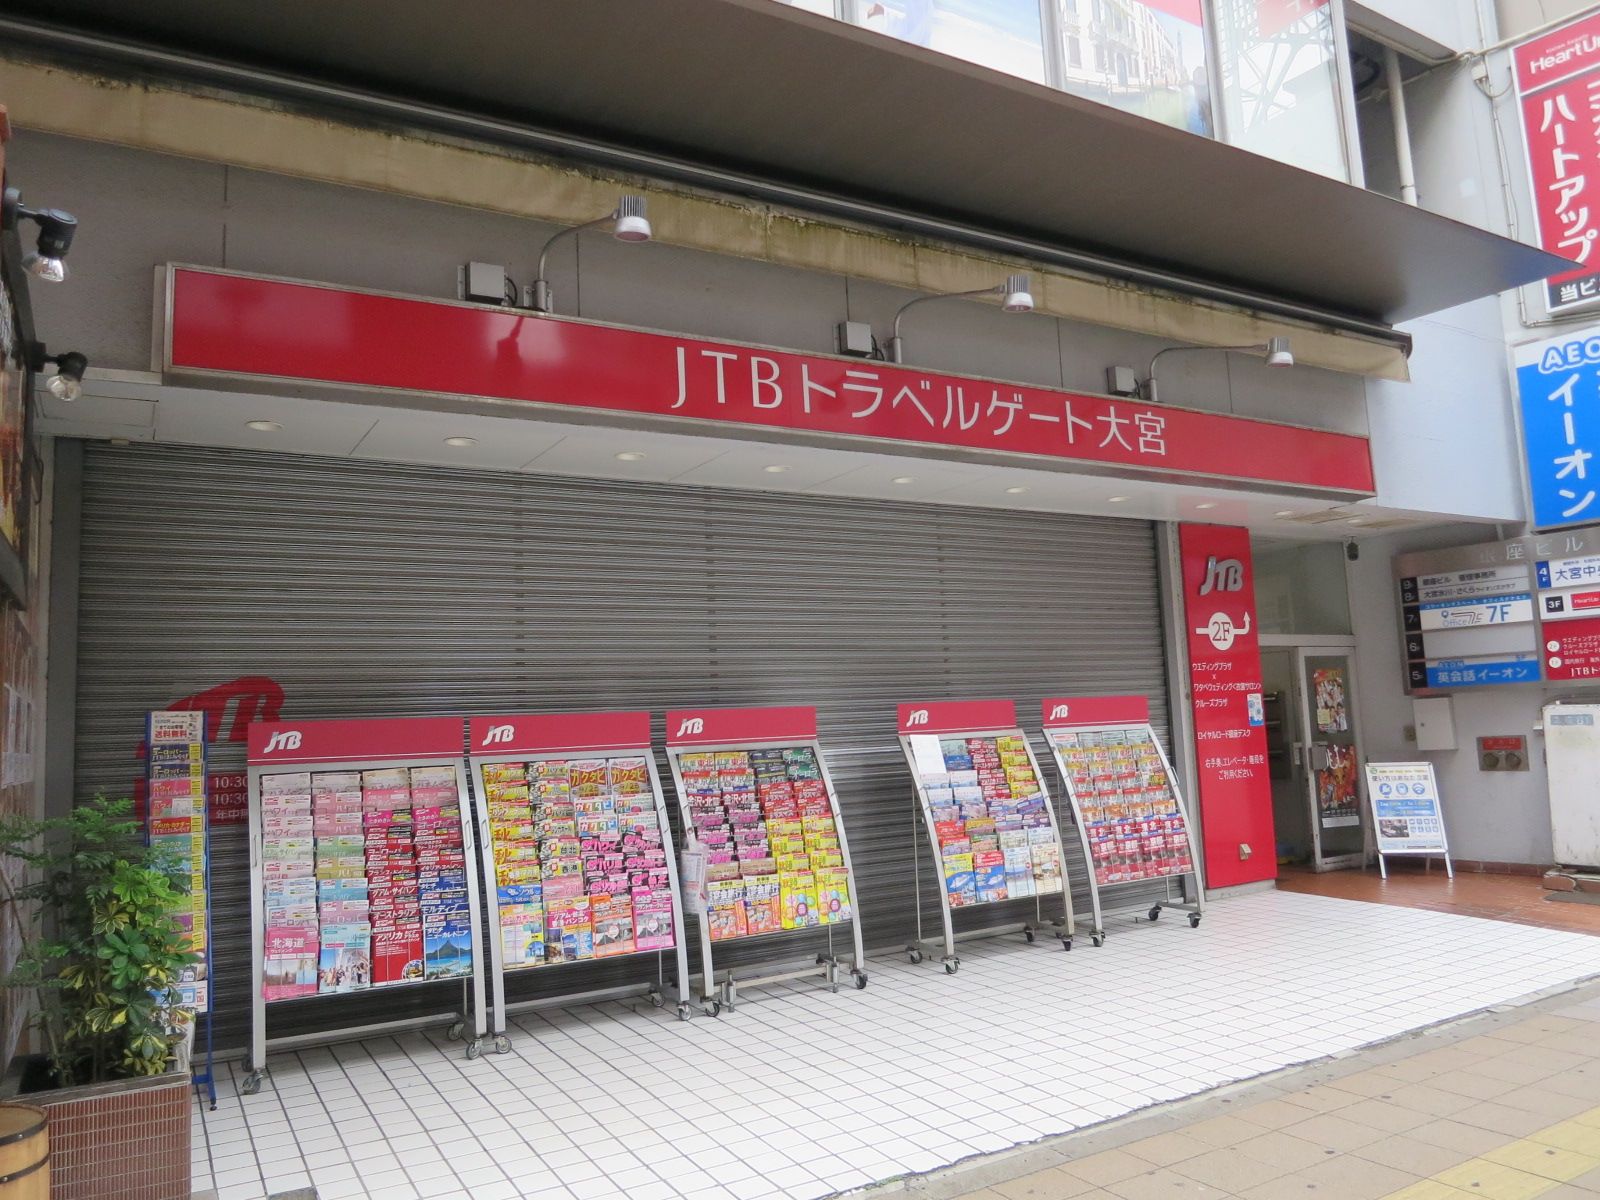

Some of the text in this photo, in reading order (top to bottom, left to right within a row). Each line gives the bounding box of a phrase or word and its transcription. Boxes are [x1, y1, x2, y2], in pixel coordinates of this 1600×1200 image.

[1540, 94, 1598, 263] ハートアップ
[671, 346, 1167, 456] JTBトラベルゲート大宮
[1547, 373, 1596, 518] イーオン
[1199, 555, 1244, 595] JTB
[1485, 603, 1512, 623] 7F
[1548, 599, 1561, 609] 3F
[1212, 620, 1231, 642] 2F
[905, 709, 929, 728] JTB
[1049, 704, 1069, 721] JTB
[481, 724, 515, 746] JTB
[676, 717, 704, 737] JTB
[263, 729, 303, 753] JTB
[371, 886, 415, 898] グアム・サイパン
[373, 909, 417, 921] オーストラリア
[271, 937, 305, 949] 北海道
